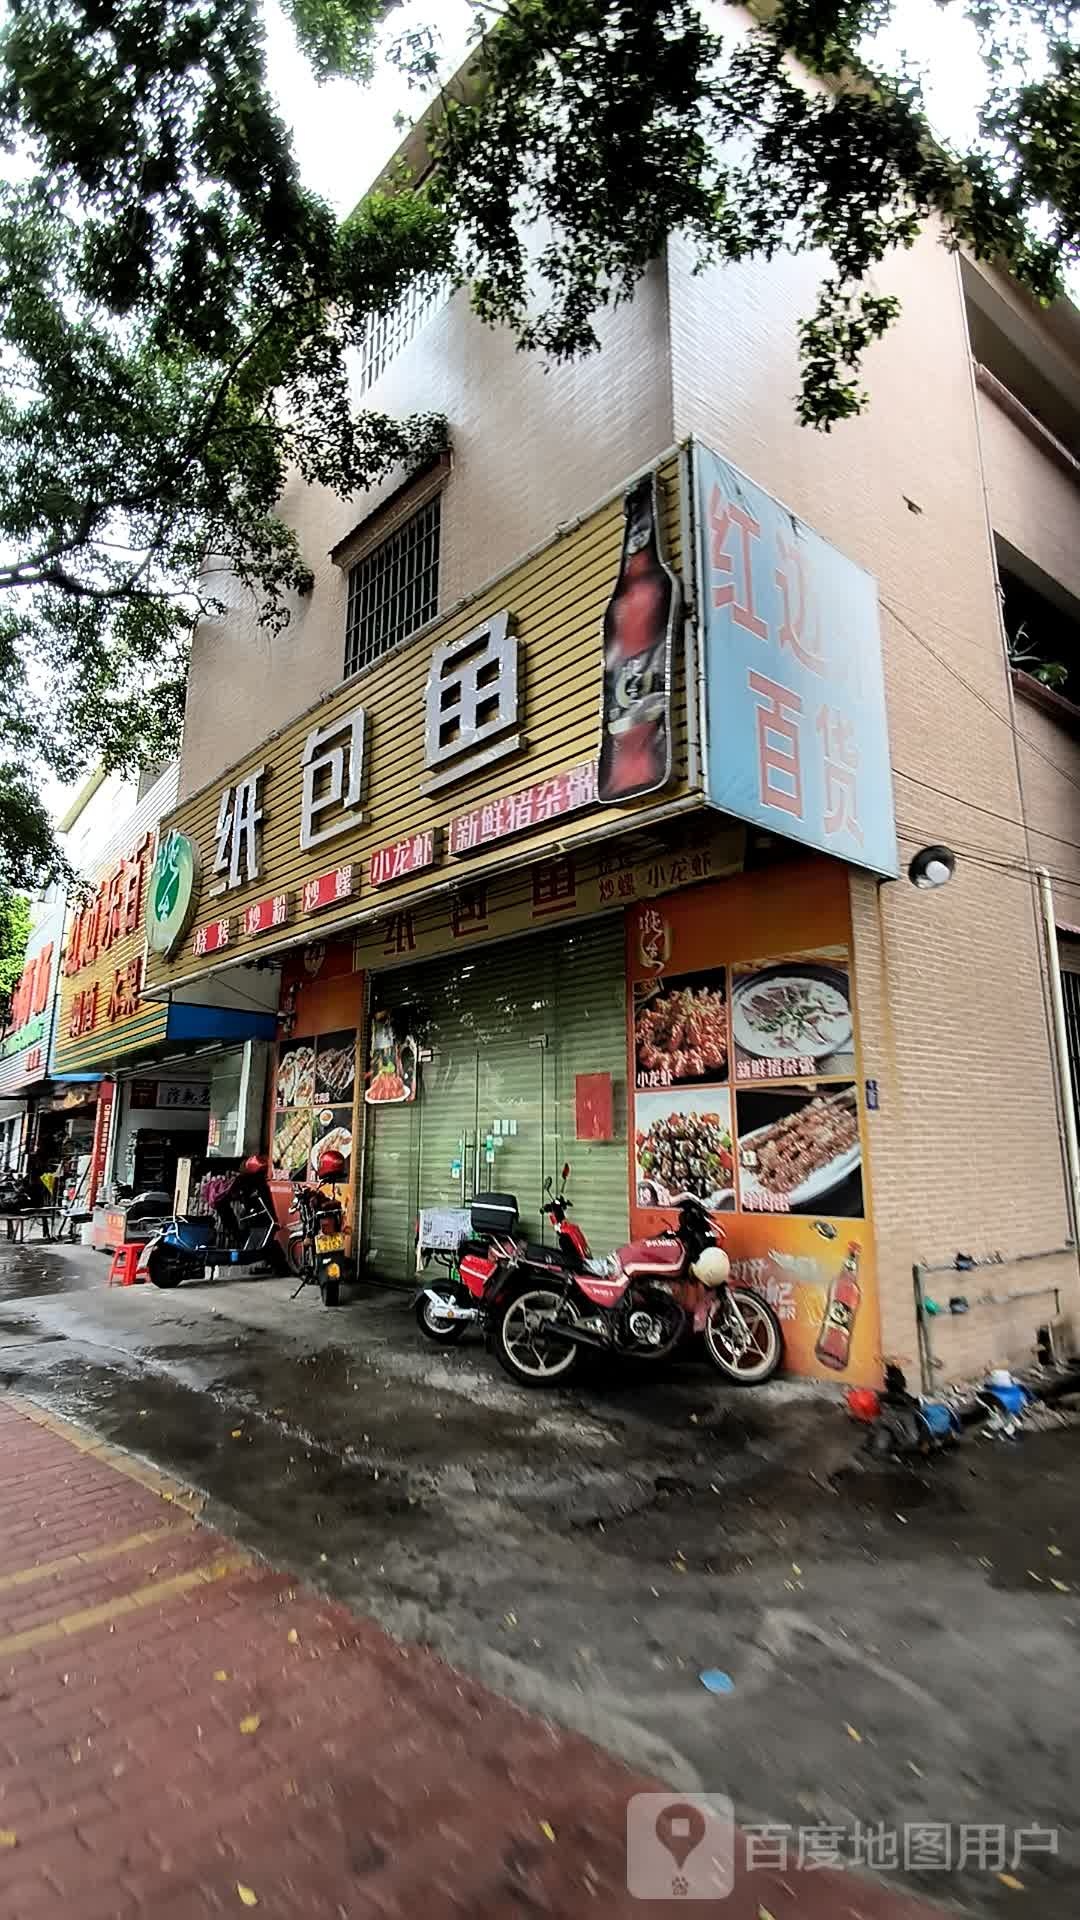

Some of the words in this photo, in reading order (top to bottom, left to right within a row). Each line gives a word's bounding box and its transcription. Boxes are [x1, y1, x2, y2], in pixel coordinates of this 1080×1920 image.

[209, 609, 523, 899] 纸包鱼
[747, 666, 866, 850] 百货
[456, 762, 595, 849] 新鲜猪杂粥
[371, 831, 433, 886] 小龙虾
[245, 894, 288, 935] 炒粉
[303, 864, 352, 913] 炒螺
[193, 918, 230, 957] 烧烤
[637, 1070, 673, 1088] 小龙虾
